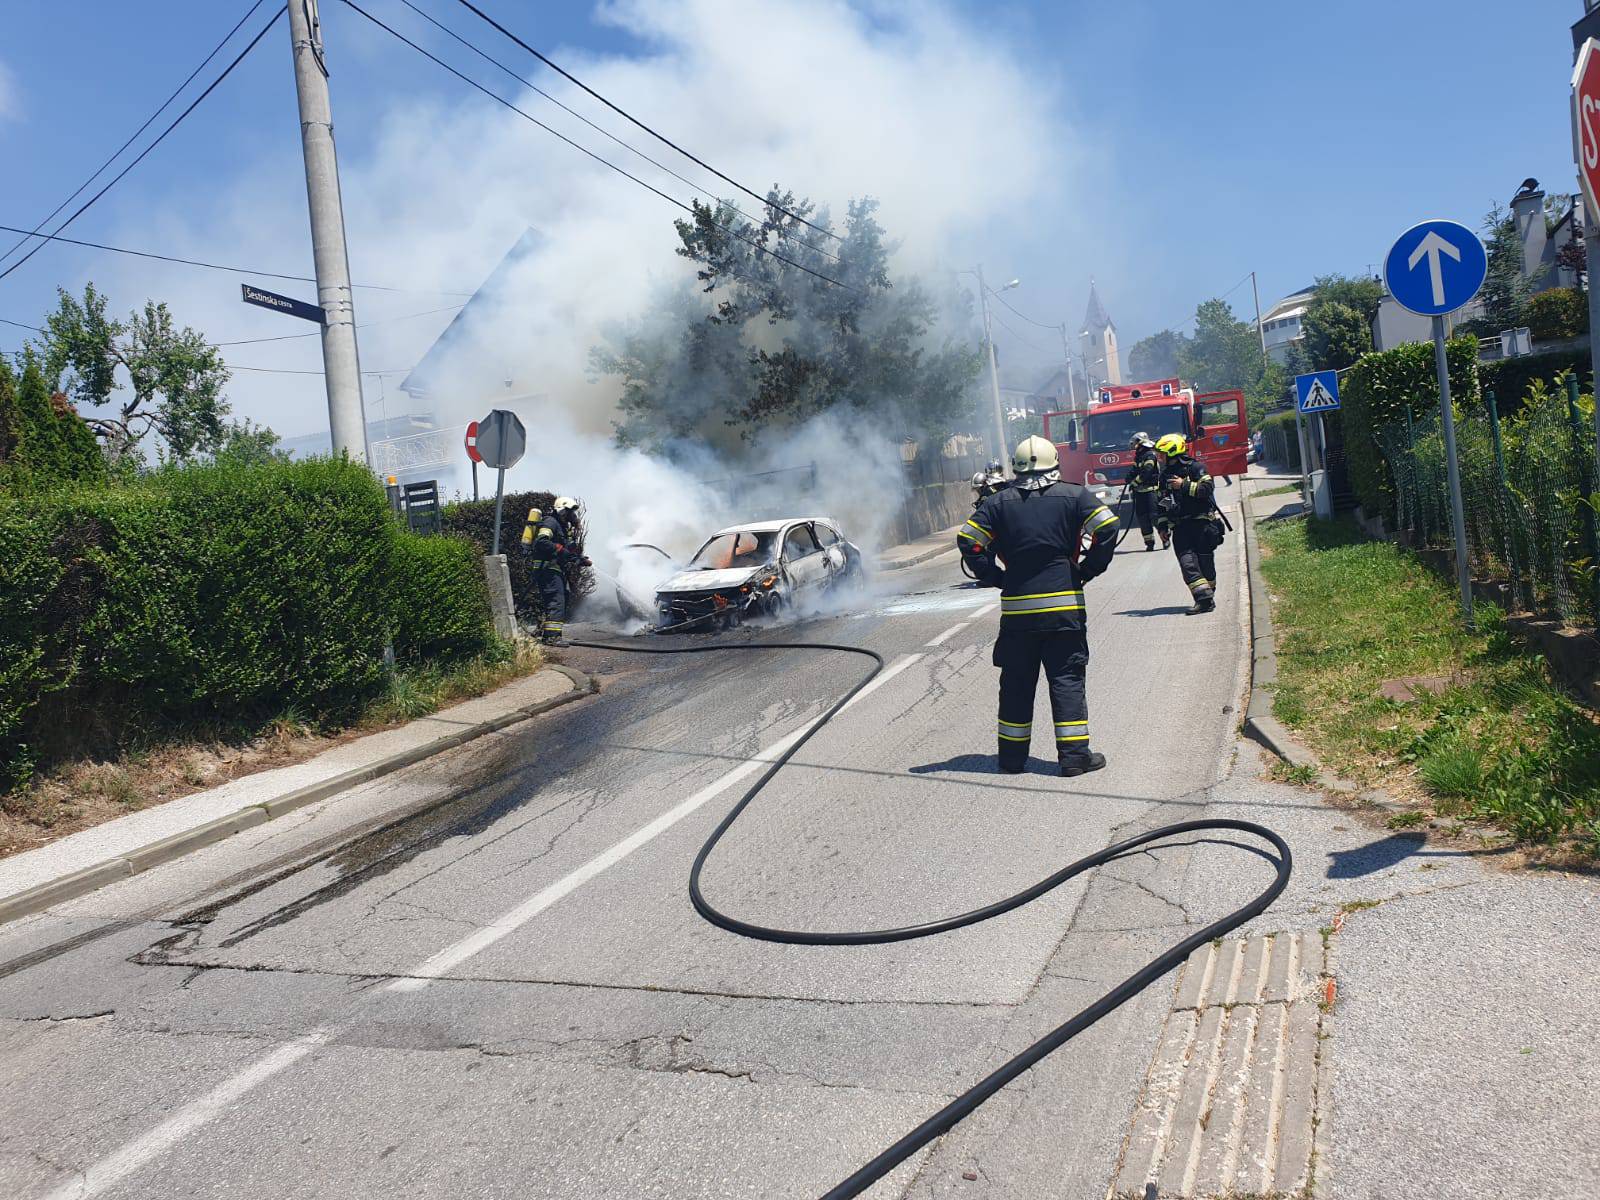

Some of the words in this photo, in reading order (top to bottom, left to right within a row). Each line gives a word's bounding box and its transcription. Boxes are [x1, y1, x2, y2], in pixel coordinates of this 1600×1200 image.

[1582, 94, 1600, 169] S
[246, 287, 278, 306] Šestinska
[1103, 455, 1116, 464] 193
